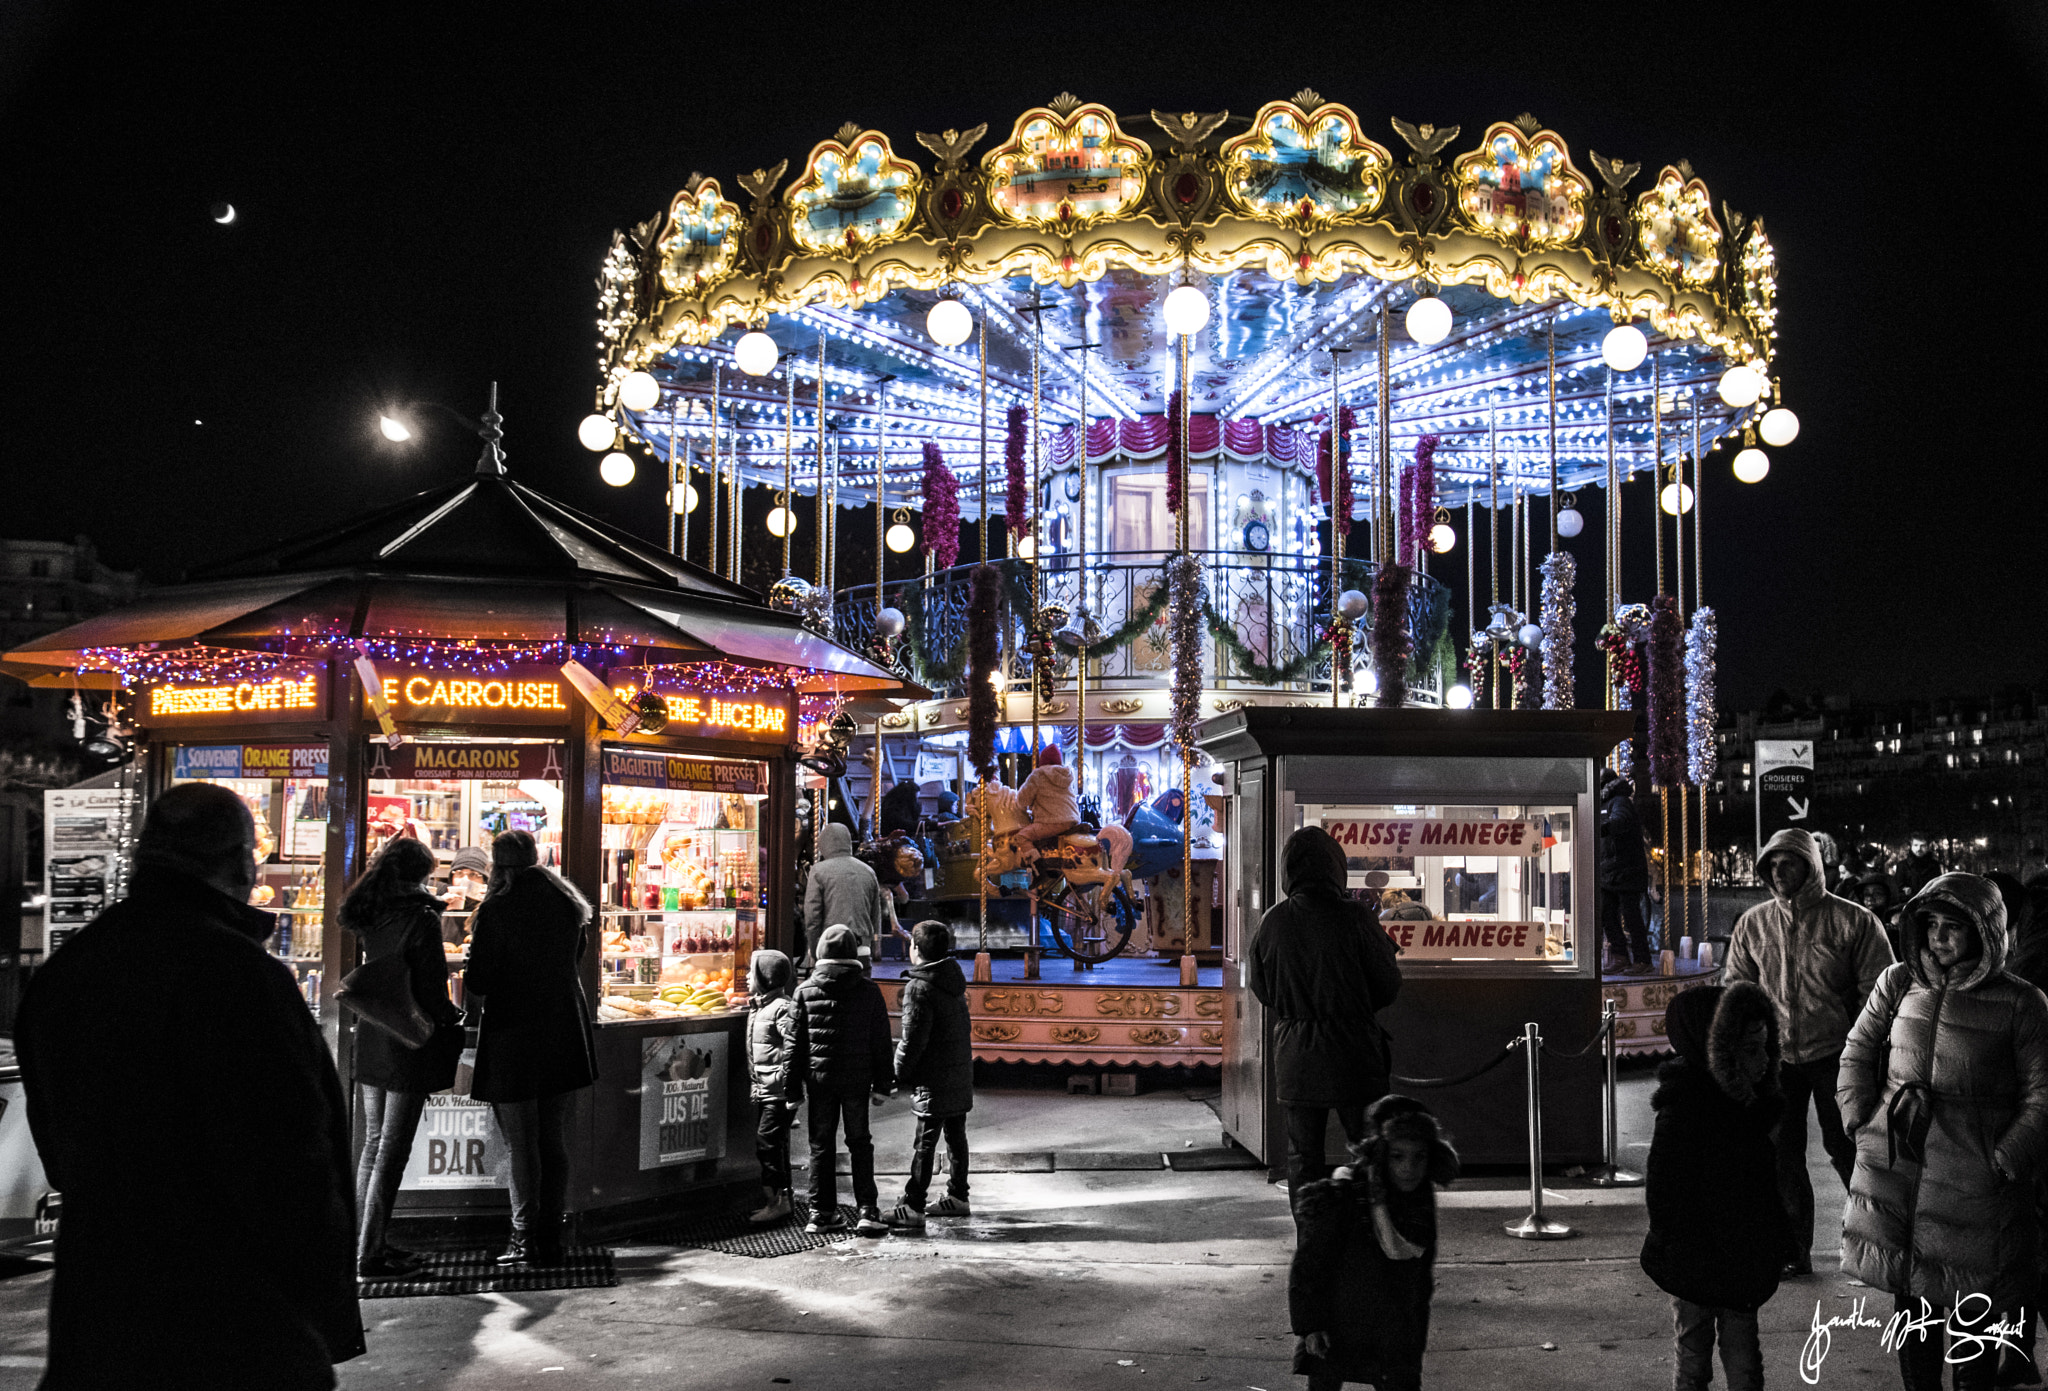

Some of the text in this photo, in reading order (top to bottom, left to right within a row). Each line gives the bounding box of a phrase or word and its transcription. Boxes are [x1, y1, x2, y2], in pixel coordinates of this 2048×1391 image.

[235, 677, 282, 710] CAFÉ
[283, 675, 317, 708] THÉ
[405, 676, 567, 709] CARROUSEL
[754, 704, 786, 731] BAR
[187, 748, 239, 767] SOUVENIR
[243, 747, 329, 767] ORANGE PRESS
[414, 747, 520, 768] MACARONS
[610, 754, 664, 778] BAGUETTE
[414, 769, 520, 779] CROISSANT PAIN AU CHOCOLAT
[668, 759, 712, 782] ORANGE
[1763, 774, 1805, 783] CROISIERES
[1763, 783, 1794, 792] CRUISES
[1328, 822, 1525, 845] CAISSE MANEGE
[1422, 925, 1529, 947] MANEGE
[659, 1092, 709, 1125] JUS DE
[426, 1111, 488, 1137] JUICE
[659, 1120, 709, 1151] FRUITS
[428, 1138, 486, 1175] BAR
